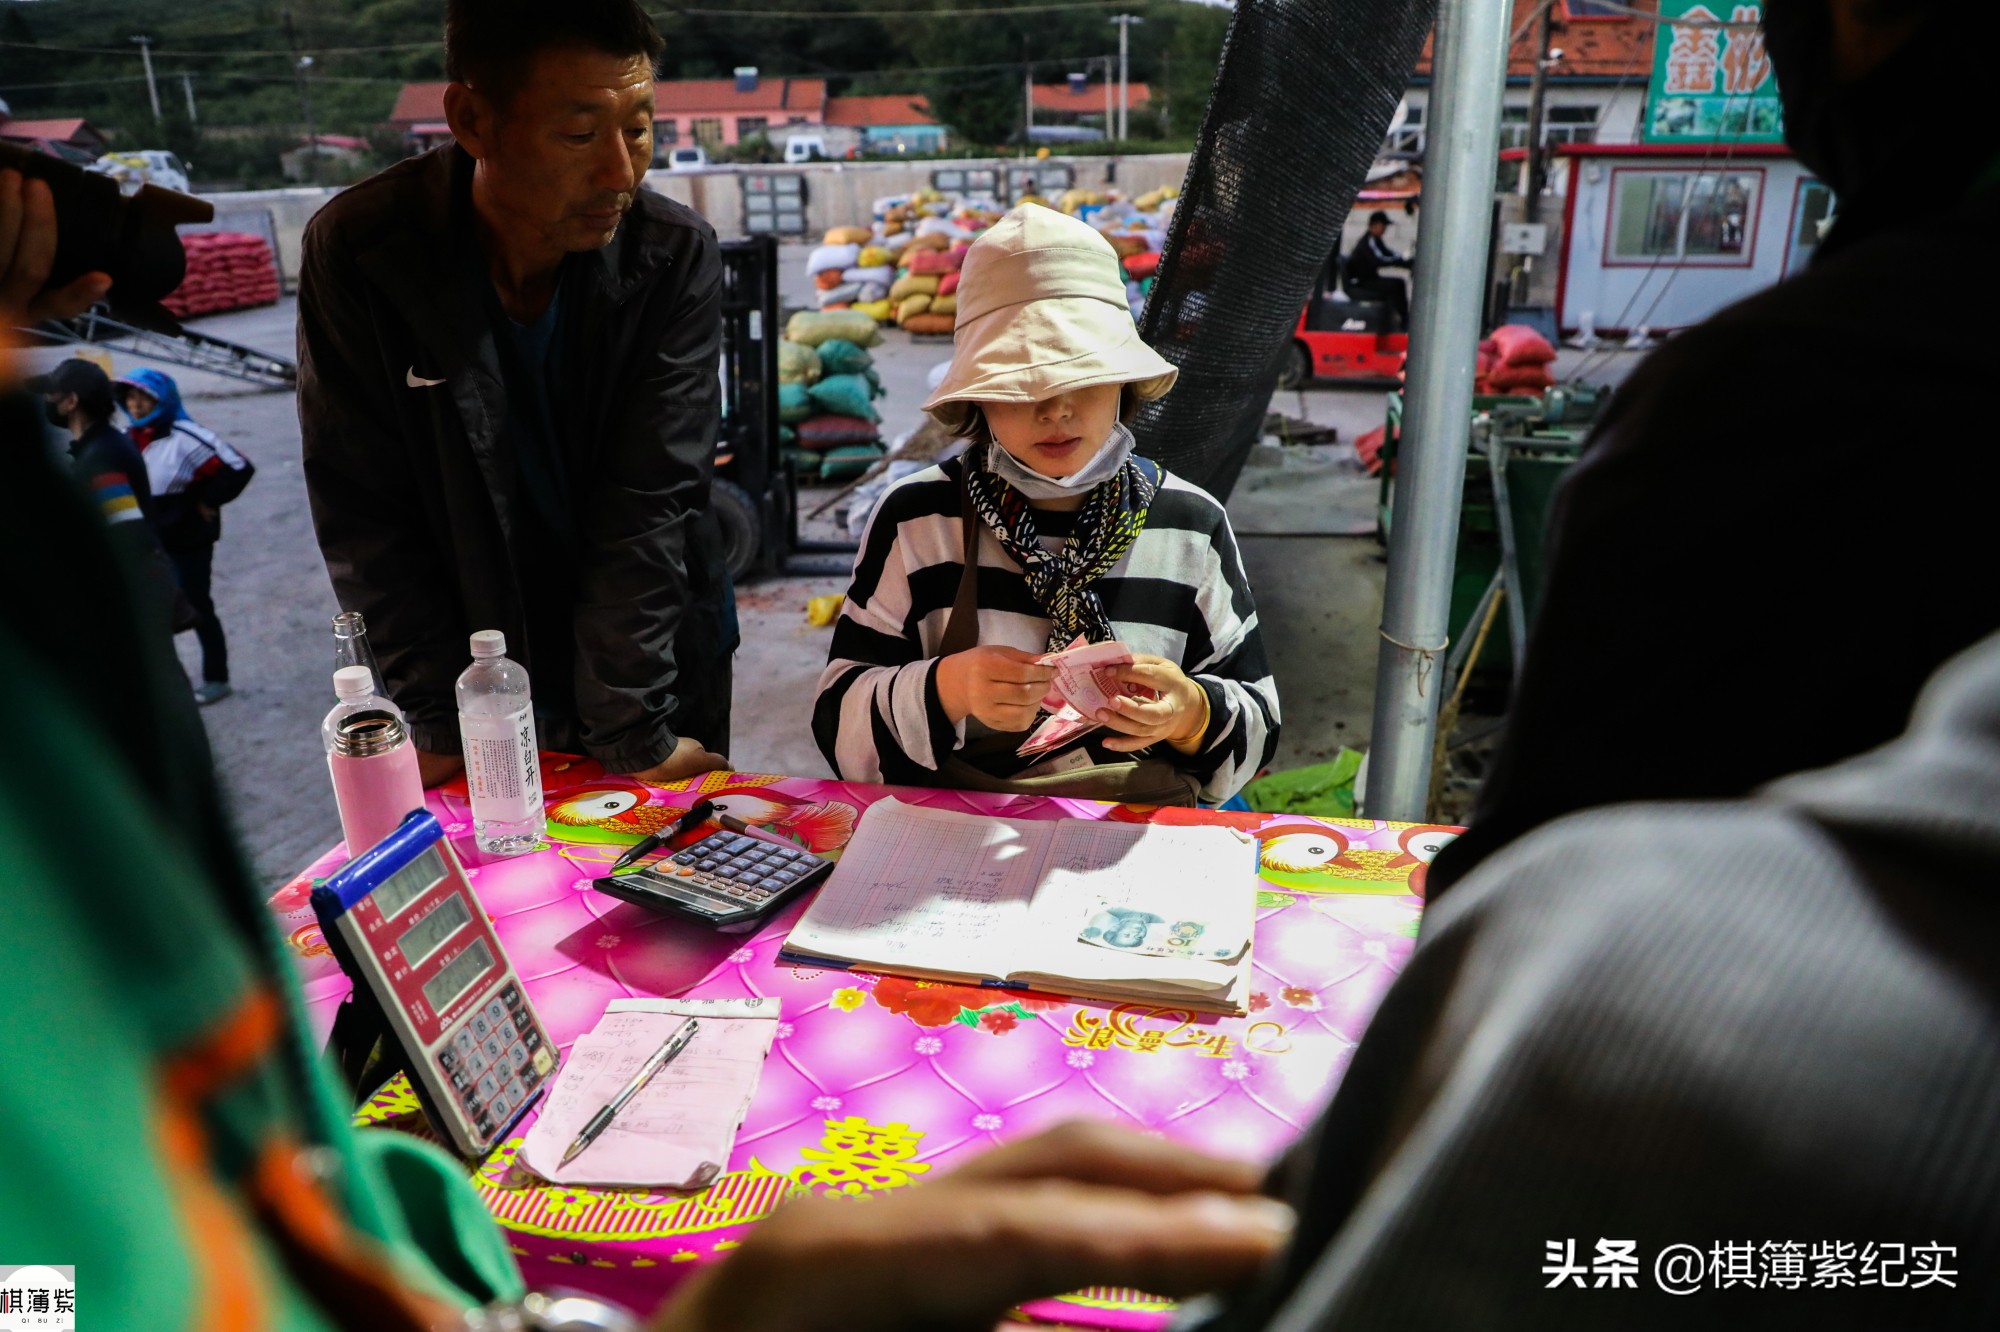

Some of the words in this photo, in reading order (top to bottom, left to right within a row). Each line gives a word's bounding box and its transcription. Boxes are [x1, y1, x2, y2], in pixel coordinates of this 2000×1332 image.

[1168, 937, 1192, 947] 10
[493, 1005, 501, 1018] 9
[477, 1020, 487, 1032] 8
[504, 1027, 512, 1039] 6
[461, 1035, 469, 1046] 7
[489, 1043, 497, 1054] 5
[515, 1048, 523, 1061] 3
[500, 1064, 509, 1077] 2
[486, 1080, 492, 1090] 1
[496, 1102, 505, 1113] 0
